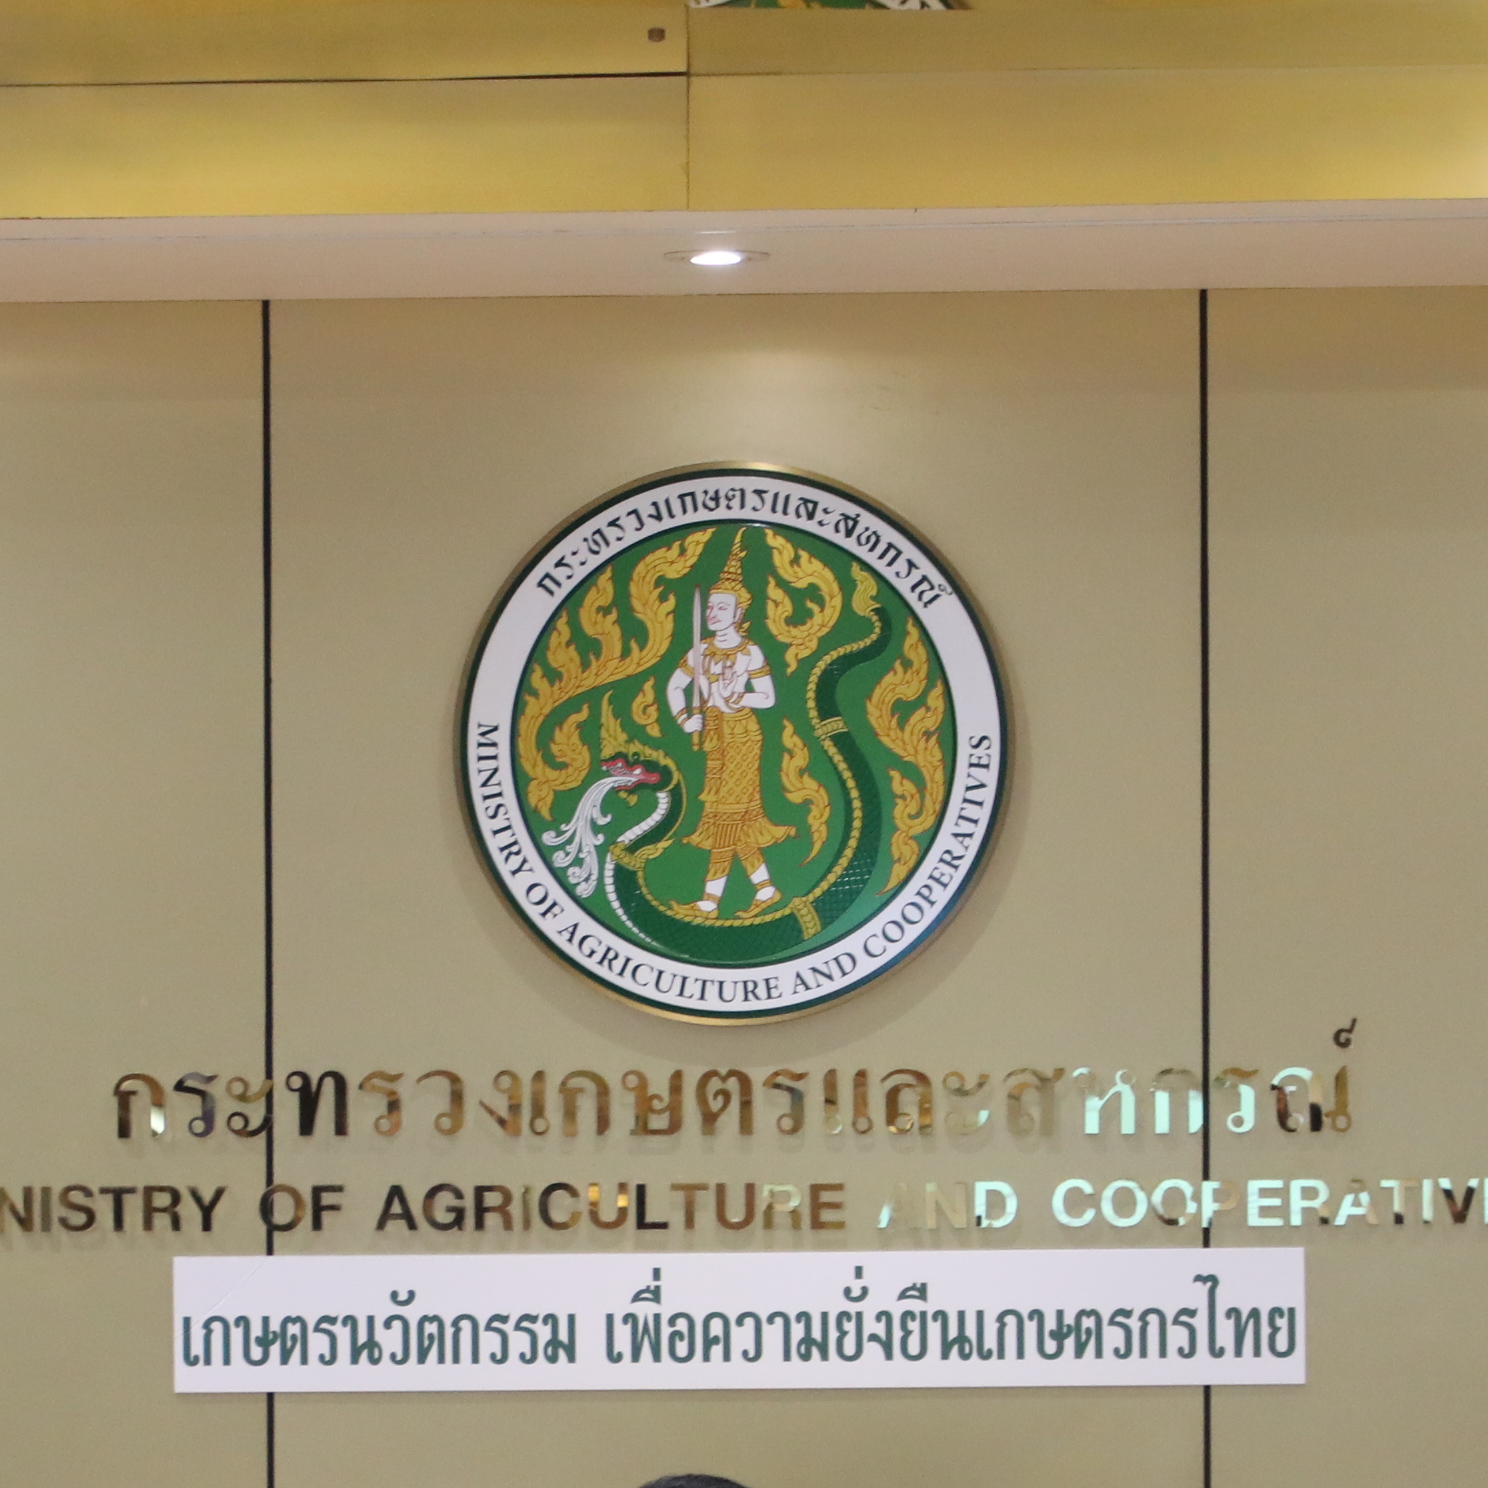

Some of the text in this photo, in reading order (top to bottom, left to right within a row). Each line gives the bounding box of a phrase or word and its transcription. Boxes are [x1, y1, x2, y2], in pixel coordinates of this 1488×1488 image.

[536, 486, 954, 609] กระทรวงเกษตรและสหกรณ์
[475, 721, 993, 1004] MINISTRY OF AGRICULTURE AND COOPERATIVES
[113, 1018, 1357, 1140] กระทรวงเกษตรและสหกรณ์
[259, 1183, 344, 1232] OF
[375, 1181, 846, 1232] AGRICULTURE
[876, 1180, 1018, 1231] AND
[182, 1266, 1298, 1368] เกษตรนวัตกรรม เพื่อความยั่งยืนเกษตรกรไทย
